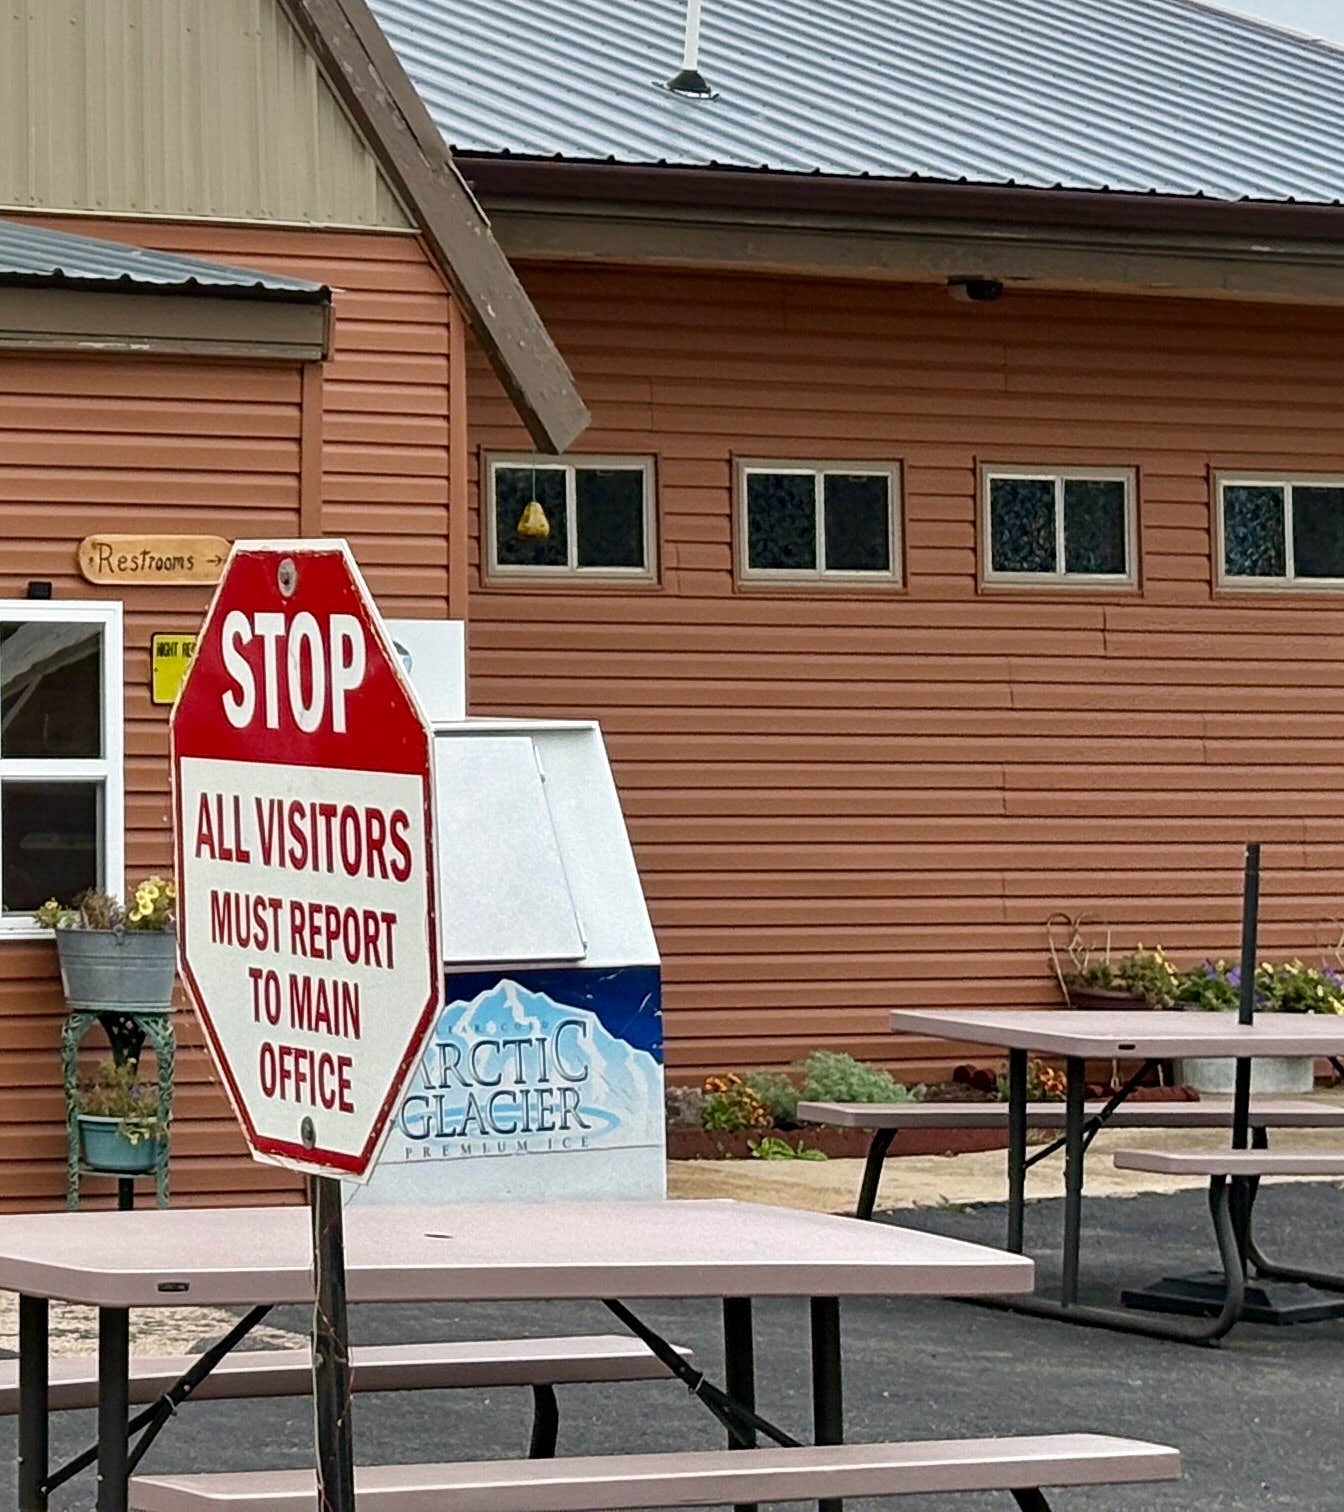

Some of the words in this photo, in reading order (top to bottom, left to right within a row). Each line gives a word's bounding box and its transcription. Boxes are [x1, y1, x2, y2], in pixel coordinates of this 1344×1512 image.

[97, 542, 195, 574] Restrooms
[221, 609, 367, 734] STOP
[195, 792, 250, 864] ALL
[255, 795, 412, 884] VISITORS
[210, 890, 283, 954] MUST
[291, 901, 397, 970] REPORT
[248, 967, 282, 1025] TO
[289, 975, 361, 1040] MAIN
[259, 1042, 354, 1114] OFFICE
[400, 1087, 591, 1141] GLACIER
[404, 1141, 528, 1159] PREMIUM
[548, 1135, 590, 1150] ICE
